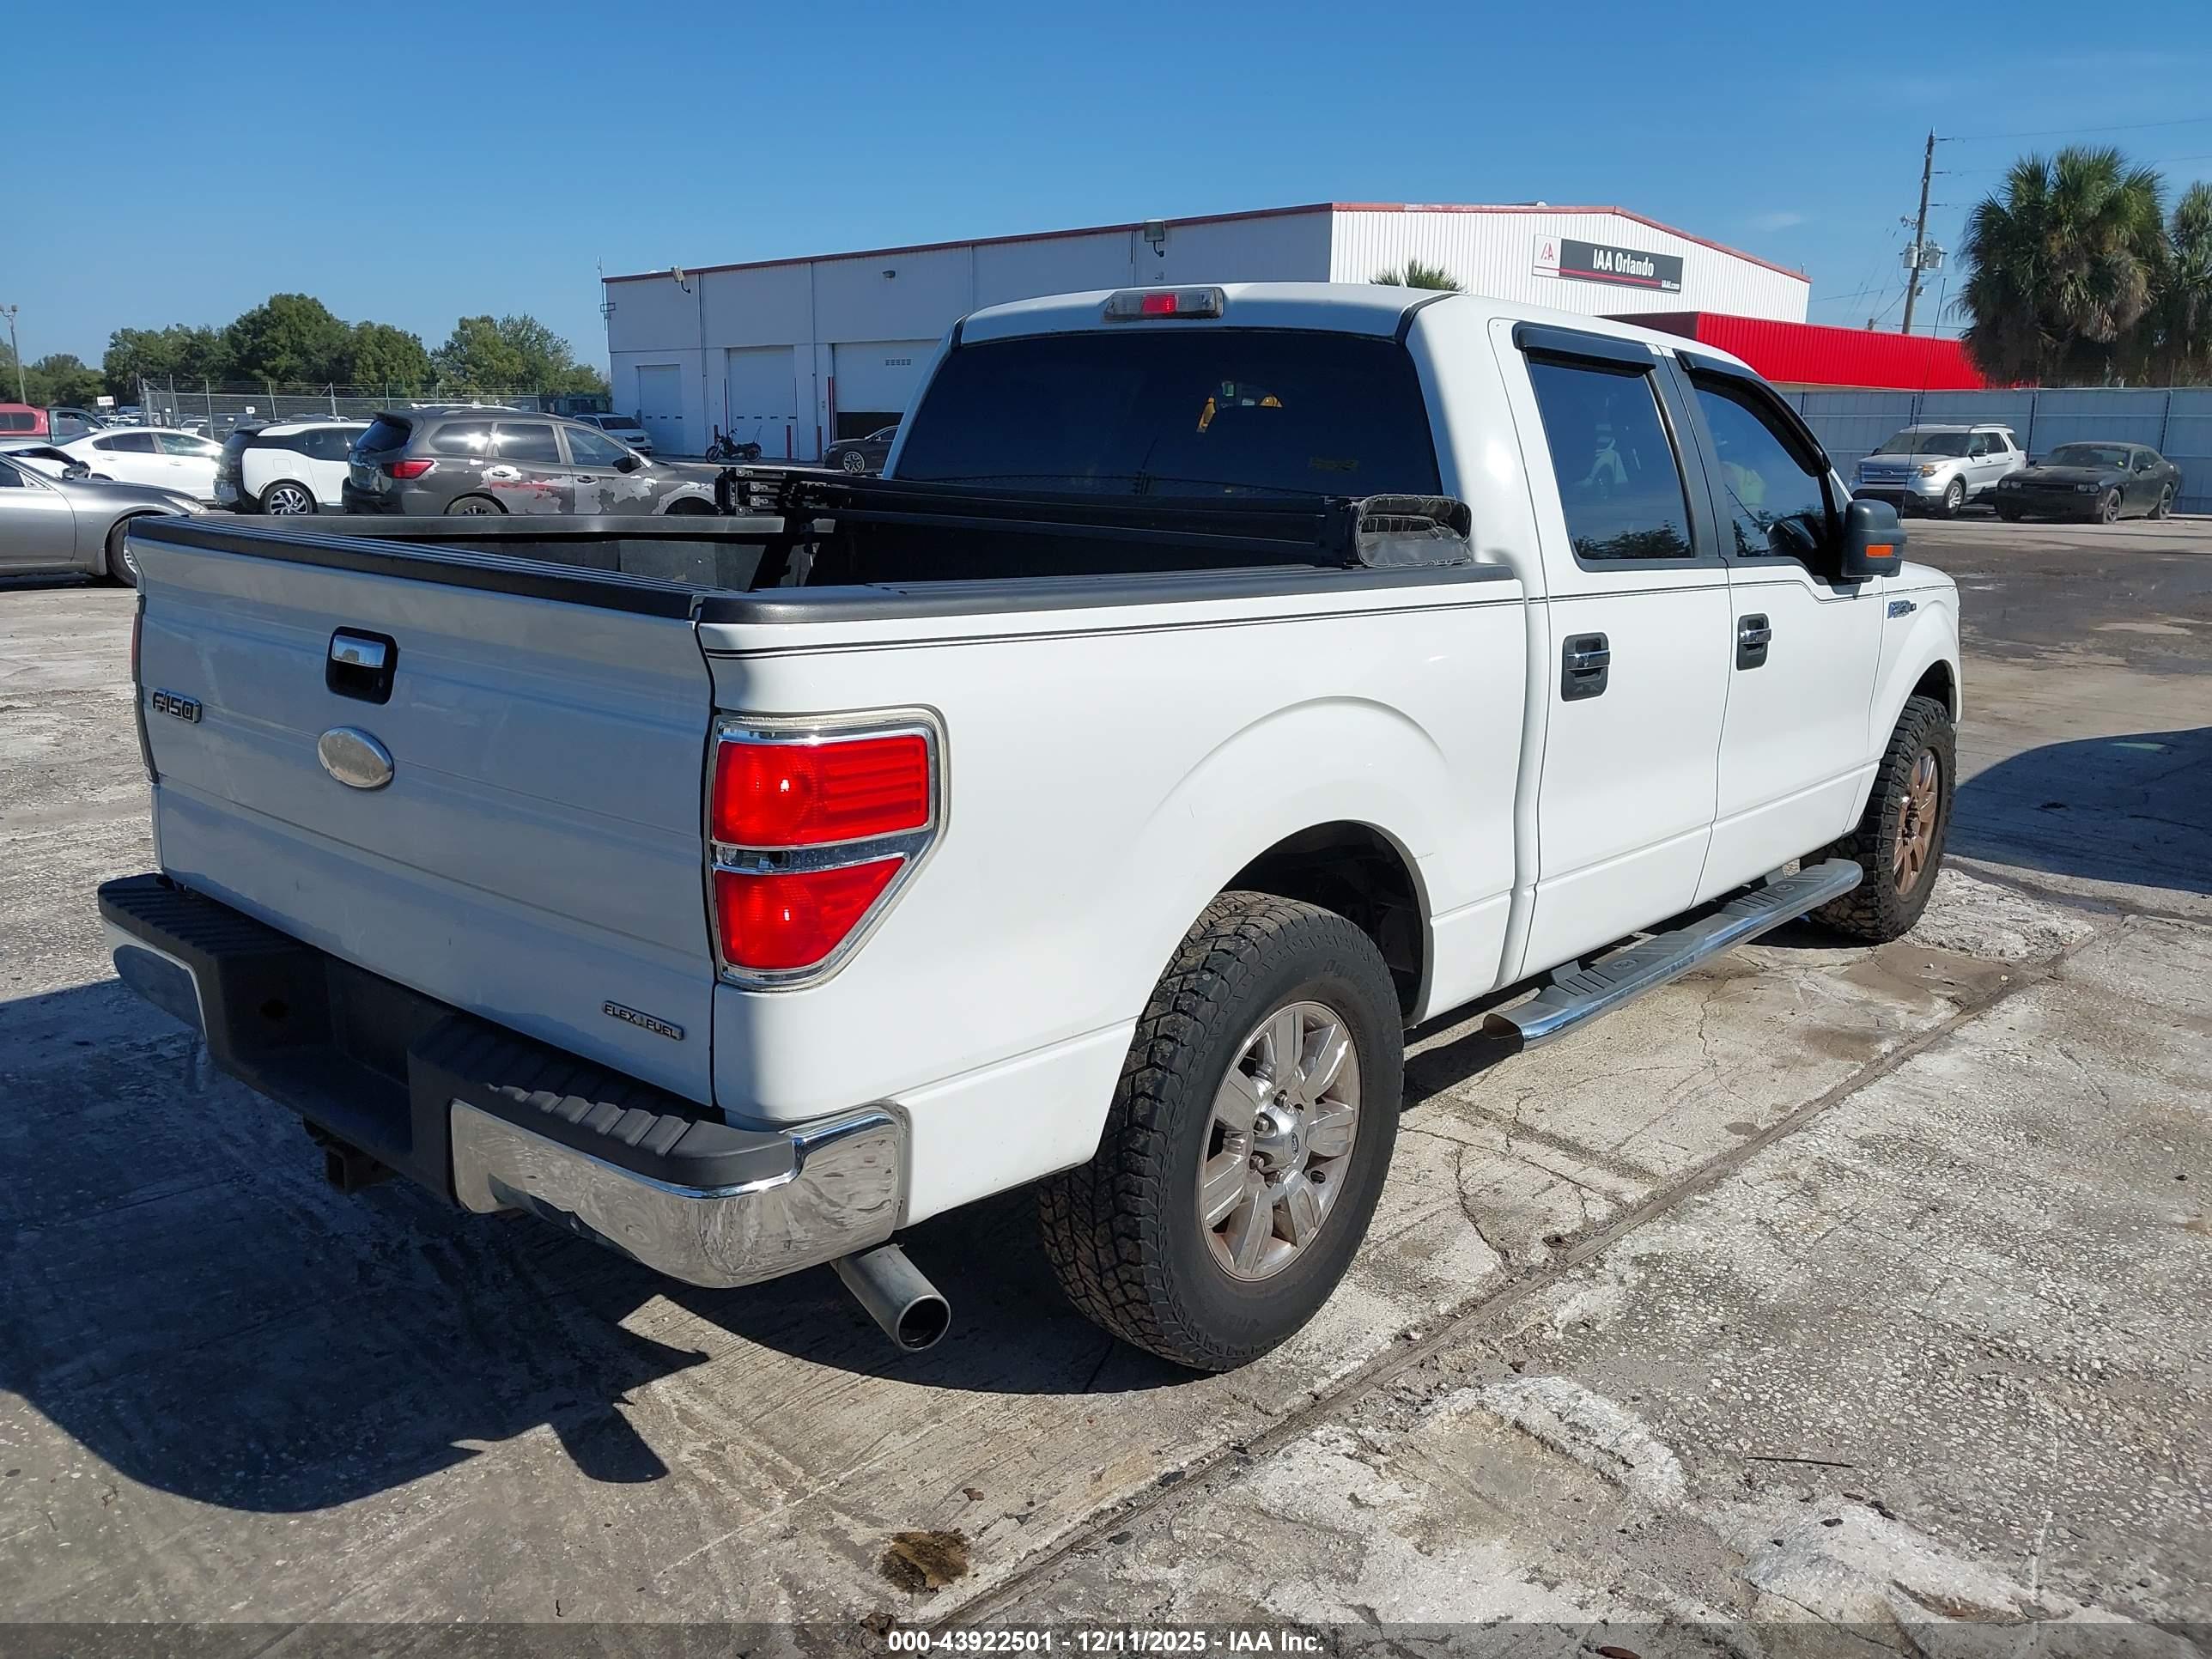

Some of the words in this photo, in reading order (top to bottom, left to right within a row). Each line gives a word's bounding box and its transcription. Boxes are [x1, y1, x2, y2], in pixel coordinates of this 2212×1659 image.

[1593, 248, 1613, 271] IAA
[1614, 252, 1655, 277] Orlando
[605, 1003, 637, 1024] FLEX
[646, 1018, 678, 1040] FUEL
